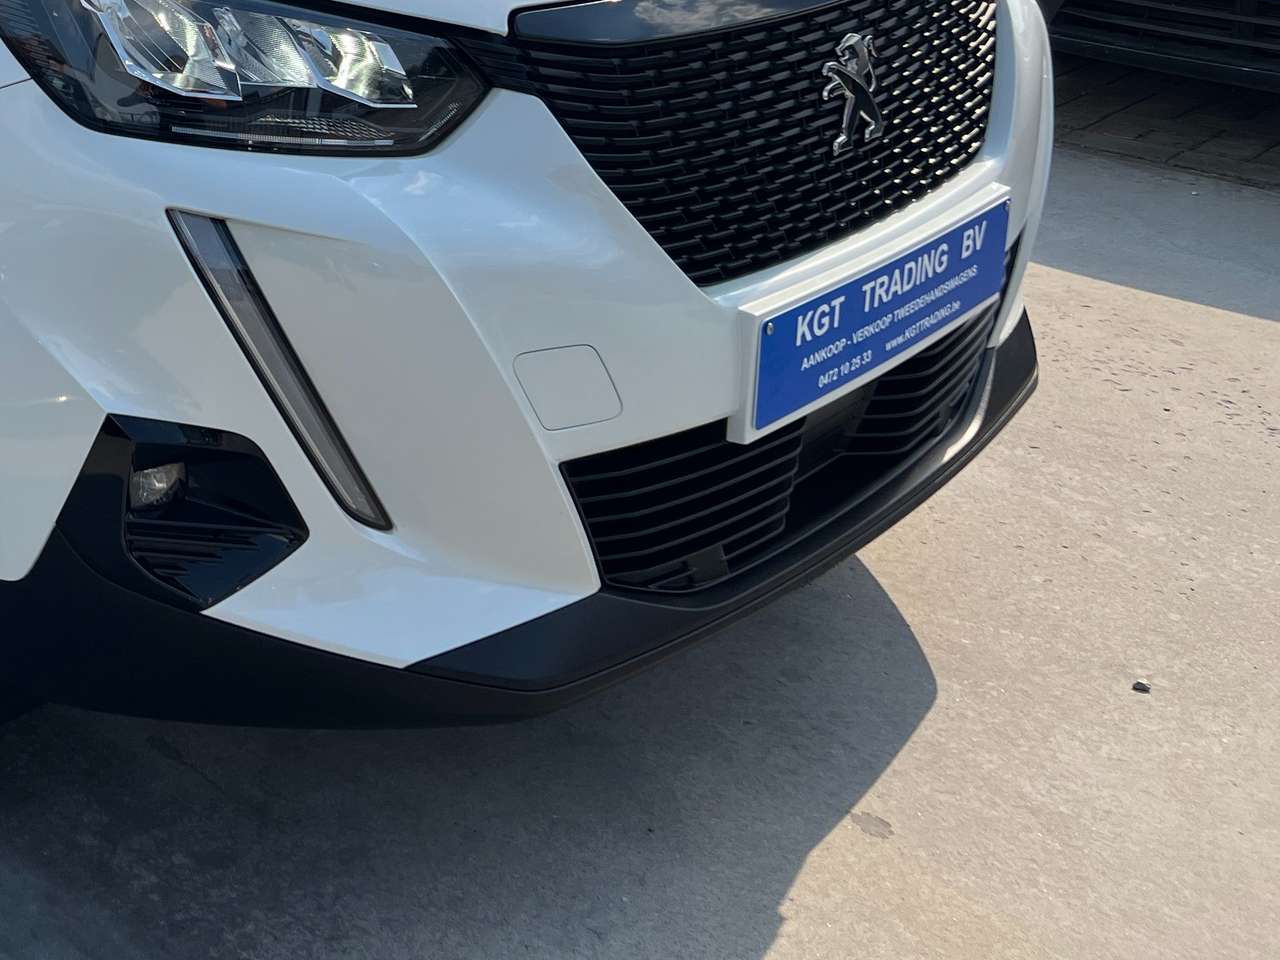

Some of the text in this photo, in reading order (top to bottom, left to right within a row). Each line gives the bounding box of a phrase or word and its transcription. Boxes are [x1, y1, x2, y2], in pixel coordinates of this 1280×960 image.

[795, 220, 988, 347] KGT TRADING BV
[801, 337, 847, 371] AANKOOP
[852, 315, 893, 345] VERKOOP
[893, 264, 978, 323] TWEEDEHANDSWAGENS
[818, 367, 838, 388] 0472
[839, 361, 850, 376] 10
[850, 355, 862, 371] 25
[862, 350, 873, 365] 33
